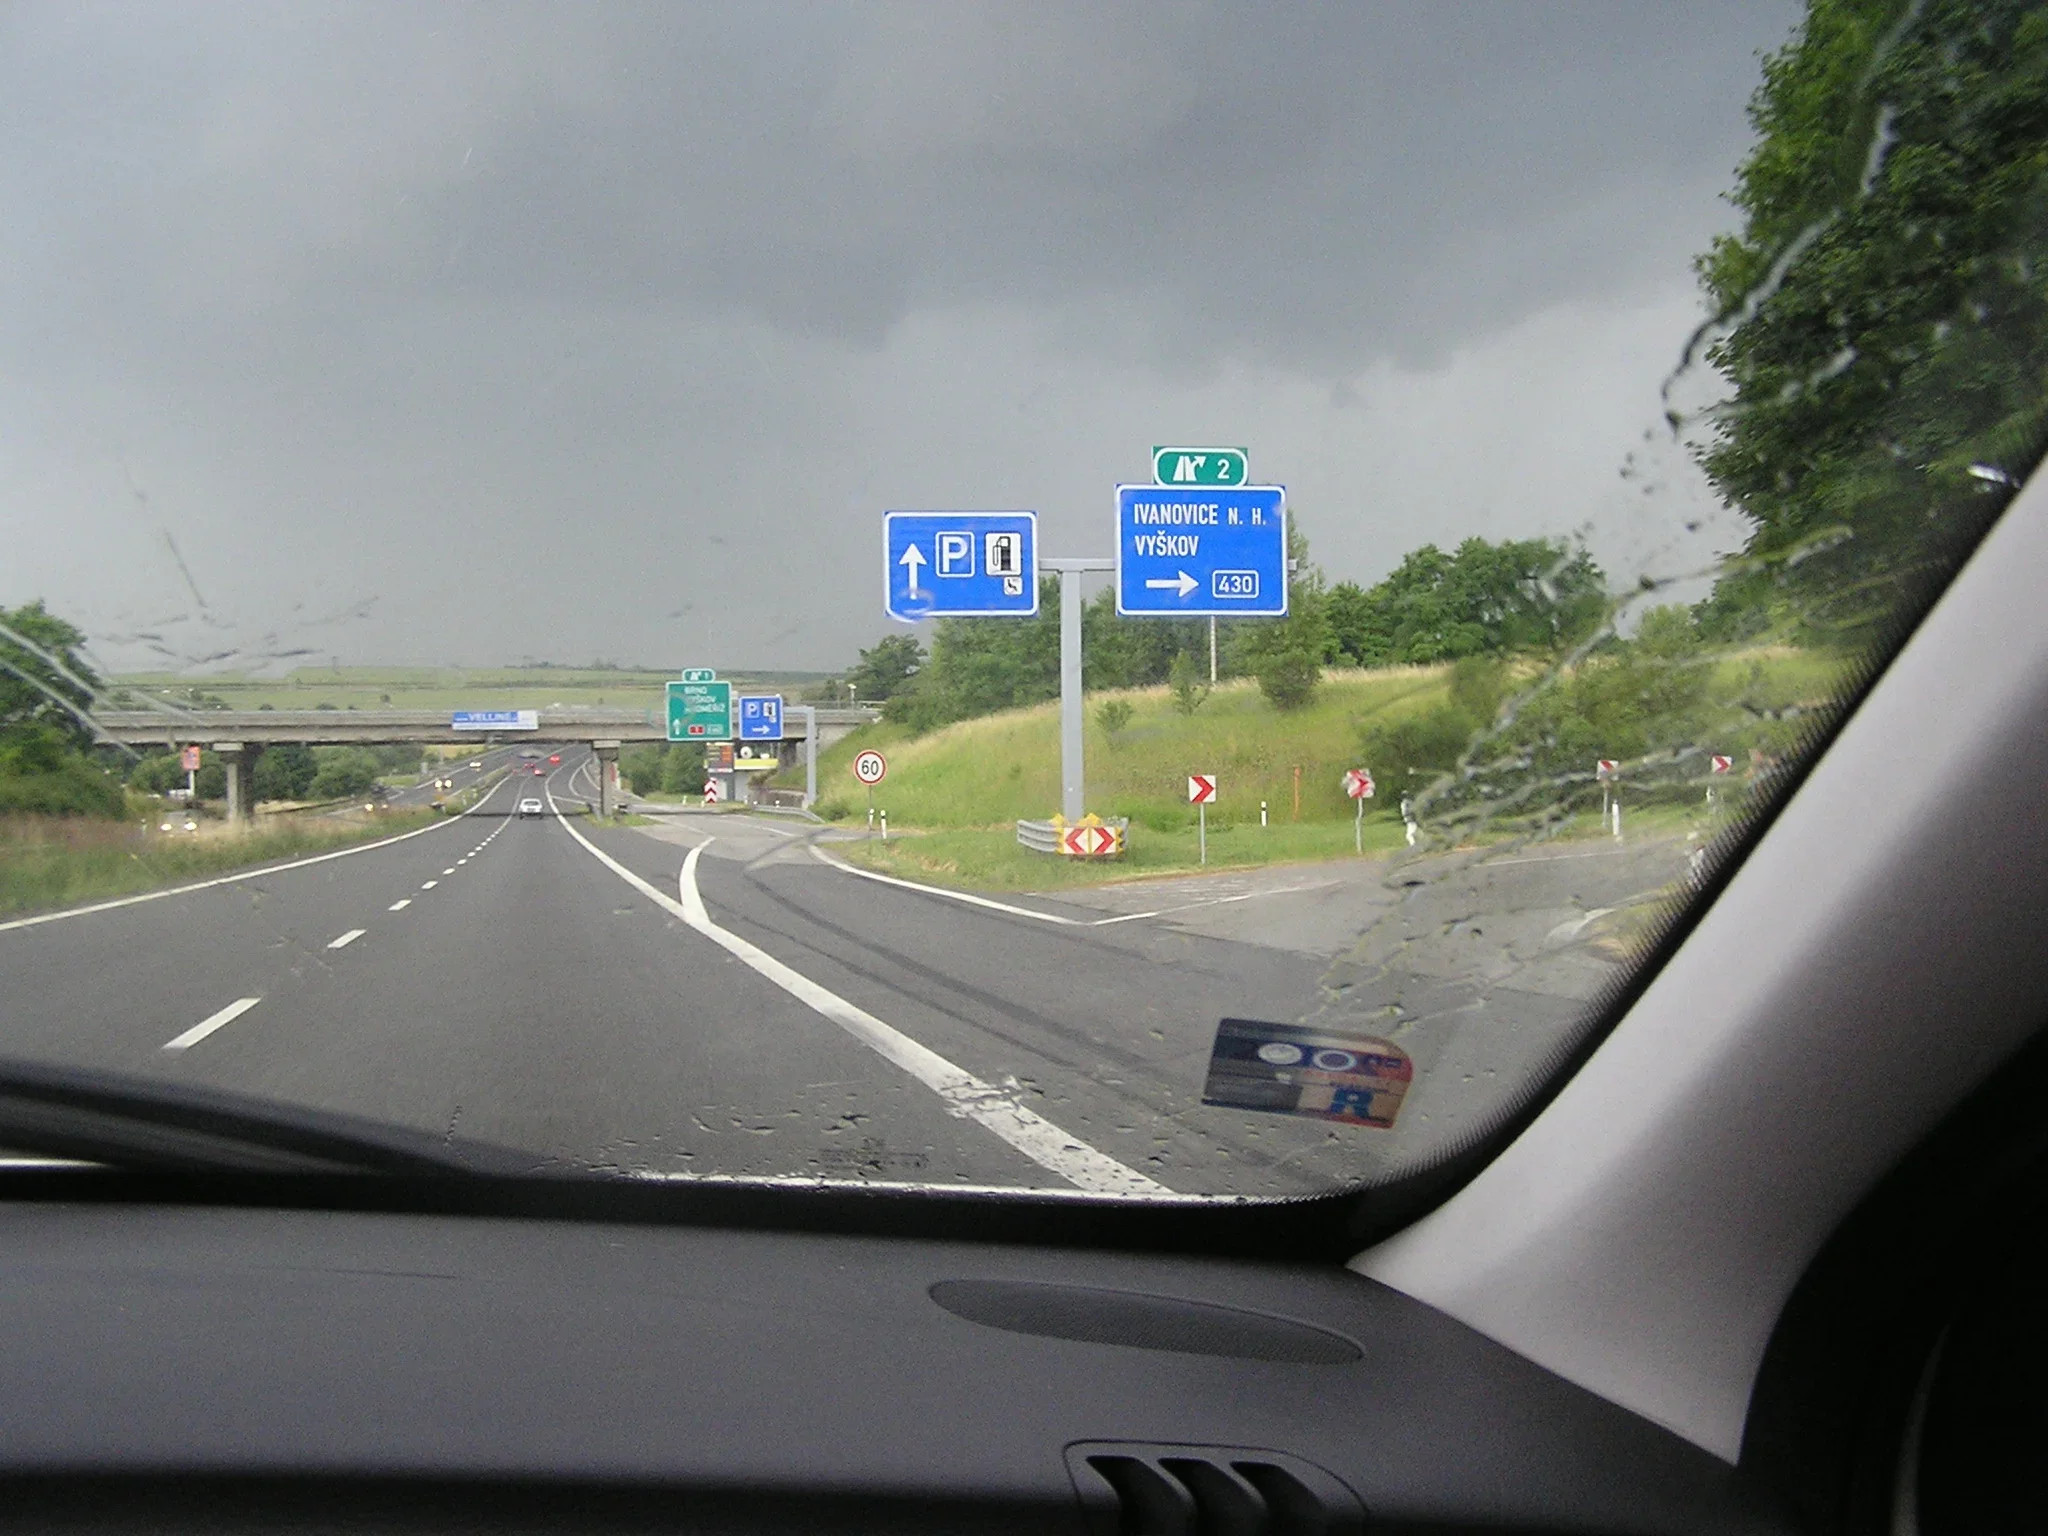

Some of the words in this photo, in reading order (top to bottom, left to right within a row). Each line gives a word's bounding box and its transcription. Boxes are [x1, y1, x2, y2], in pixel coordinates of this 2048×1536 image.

[1217, 459, 1230, 479] 2
[1133, 503, 1219, 525] IVANOVICE
[1228, 507, 1243, 525] N.
[1252, 507, 1267, 525] H.
[1134, 529, 1199, 556] VYŠKOV
[942, 536, 968, 573] P
[1218, 575, 1253, 594] 430
[861, 759, 879, 776] 60
